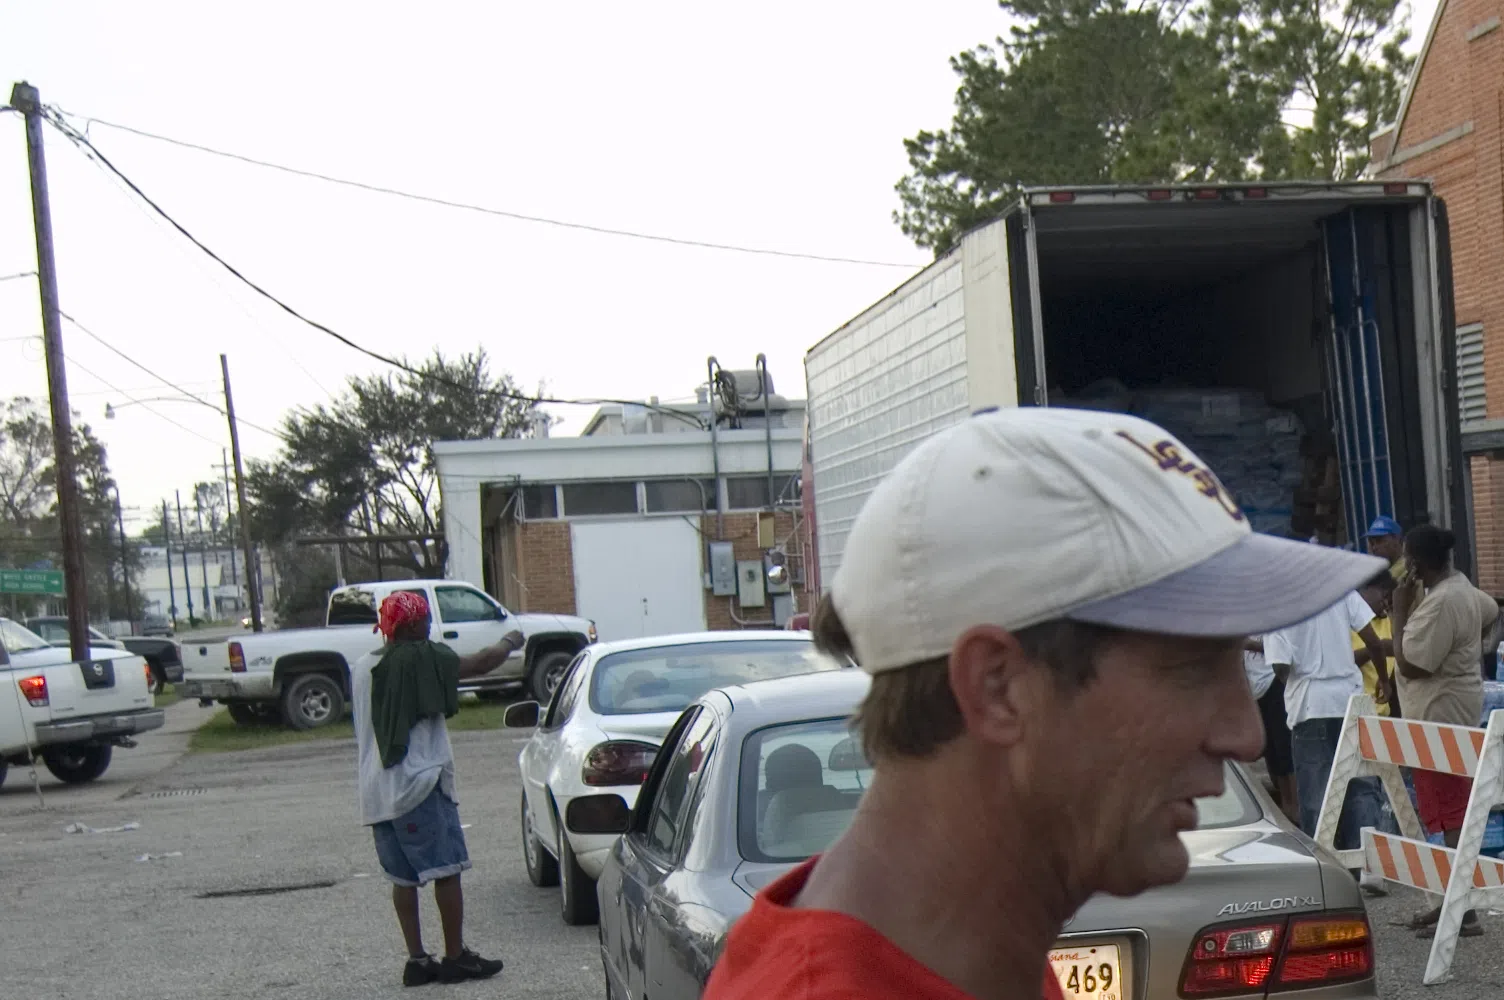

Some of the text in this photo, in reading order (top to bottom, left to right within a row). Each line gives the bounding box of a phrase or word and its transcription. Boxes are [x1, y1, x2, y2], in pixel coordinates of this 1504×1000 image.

[1216, 896, 1323, 917] AVALON XL
[1066, 963, 1113, 994] 469
